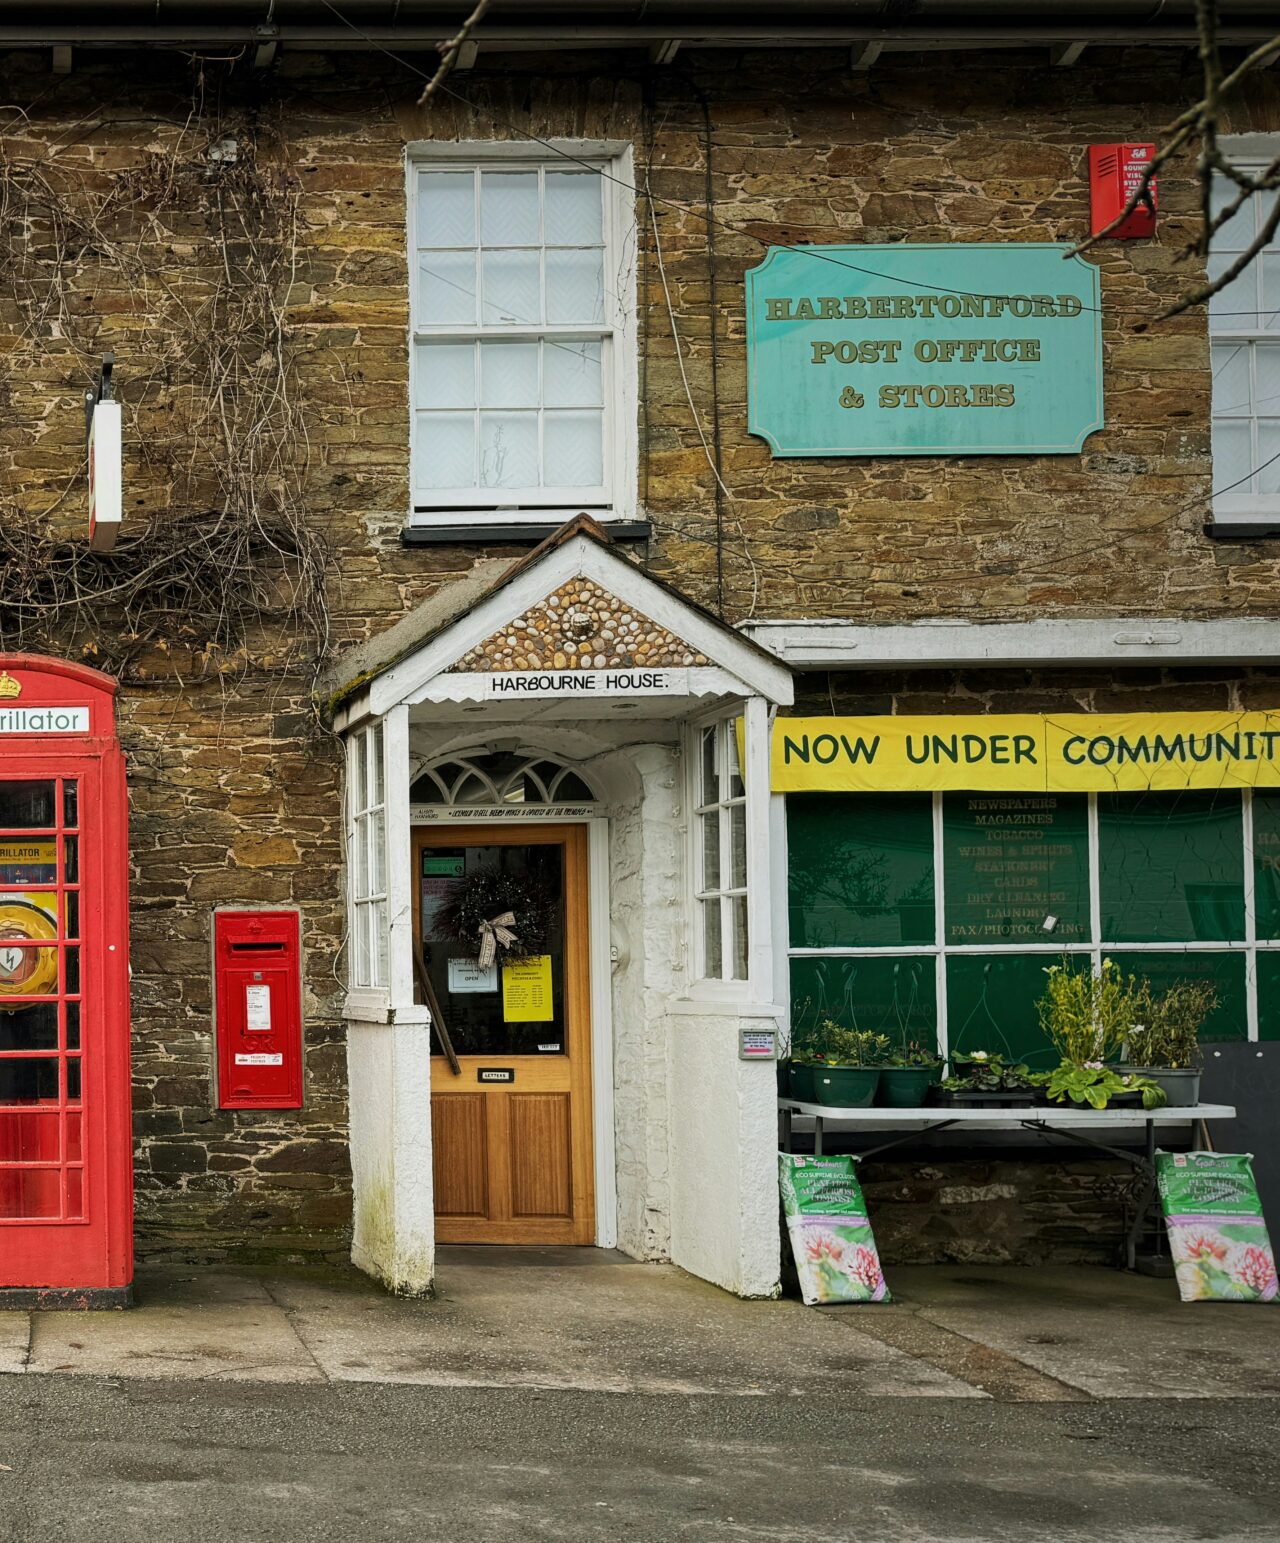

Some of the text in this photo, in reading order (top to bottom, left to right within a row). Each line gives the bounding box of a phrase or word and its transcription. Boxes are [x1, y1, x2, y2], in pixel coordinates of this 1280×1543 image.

[765, 294, 1082, 321] HARBERTONFORD
[811, 338, 1041, 364] POST OFFICE
[838, 384, 1016, 408] & STORES
[492, 673, 669, 692] HARBOURNE HOUSE.
[783, 731, 1280, 765] NOW UNDER COMMUNIT
[968, 798, 1057, 810] NEWSPAPERS
[975, 814, 1053, 825] MAGAZINES
[985, 830, 1044, 840] TOBACCO
[959, 846, 1003, 857] WINES
[975, 861, 1056, 872] STATIONERY
[994, 877, 1038, 888] CARDS
[967, 893, 993, 904] DRY
[986, 907, 1050, 919] LAUNDRY
